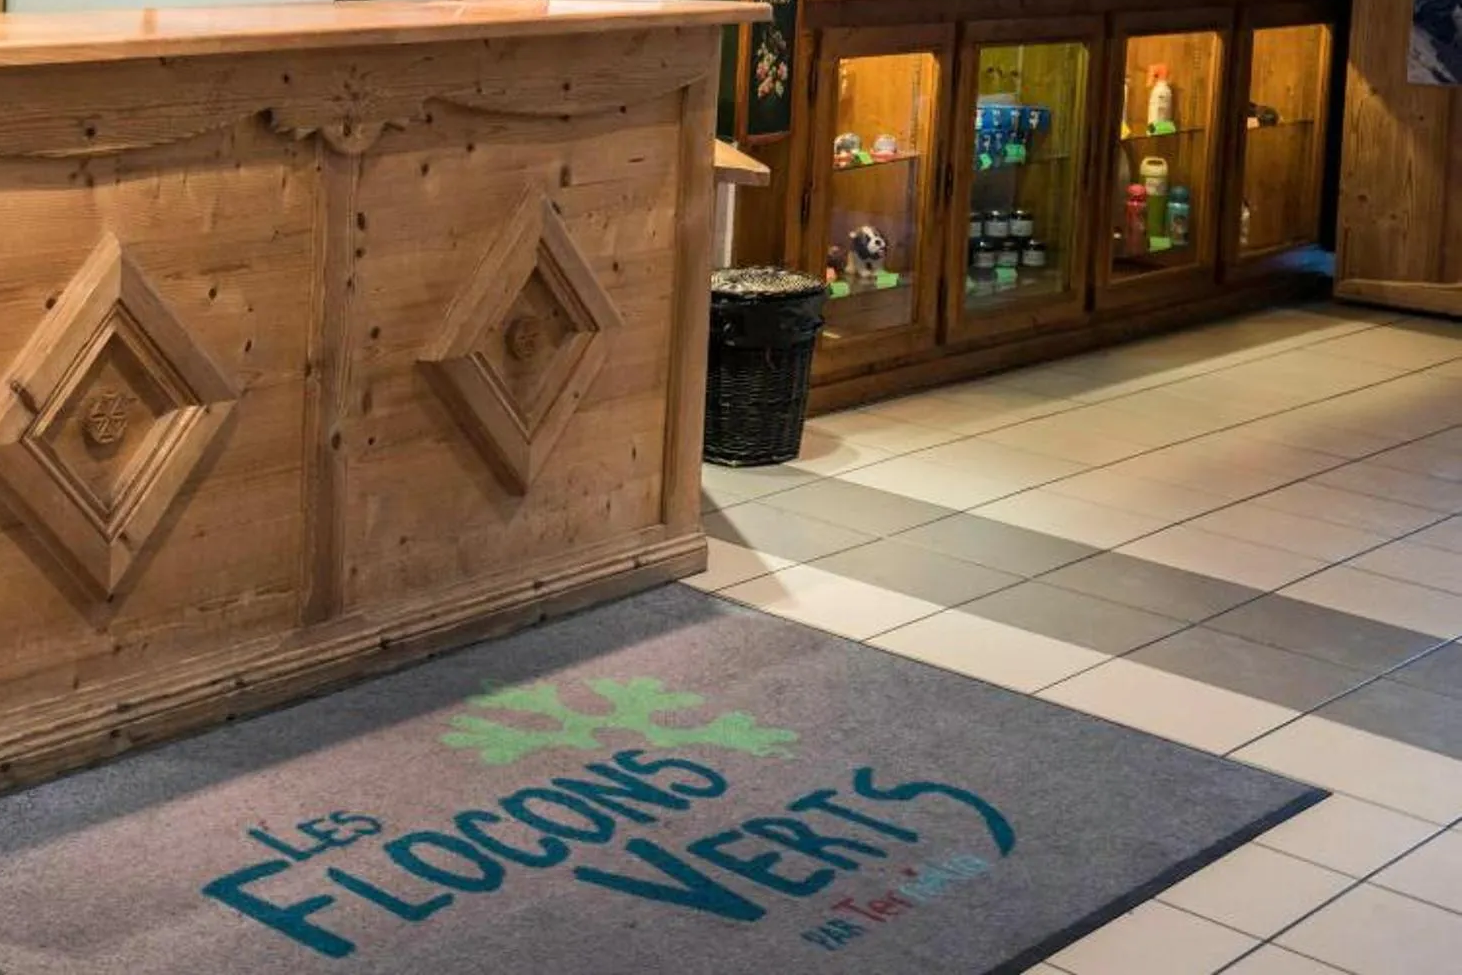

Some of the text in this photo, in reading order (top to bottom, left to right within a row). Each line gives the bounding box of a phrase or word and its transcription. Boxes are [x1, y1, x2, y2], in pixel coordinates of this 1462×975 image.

[202, 749, 729, 958] FLOCONS
[248, 810, 382, 862] LES
[573, 766, 1017, 923] VERTS
[800, 918, 869, 952] PAR
